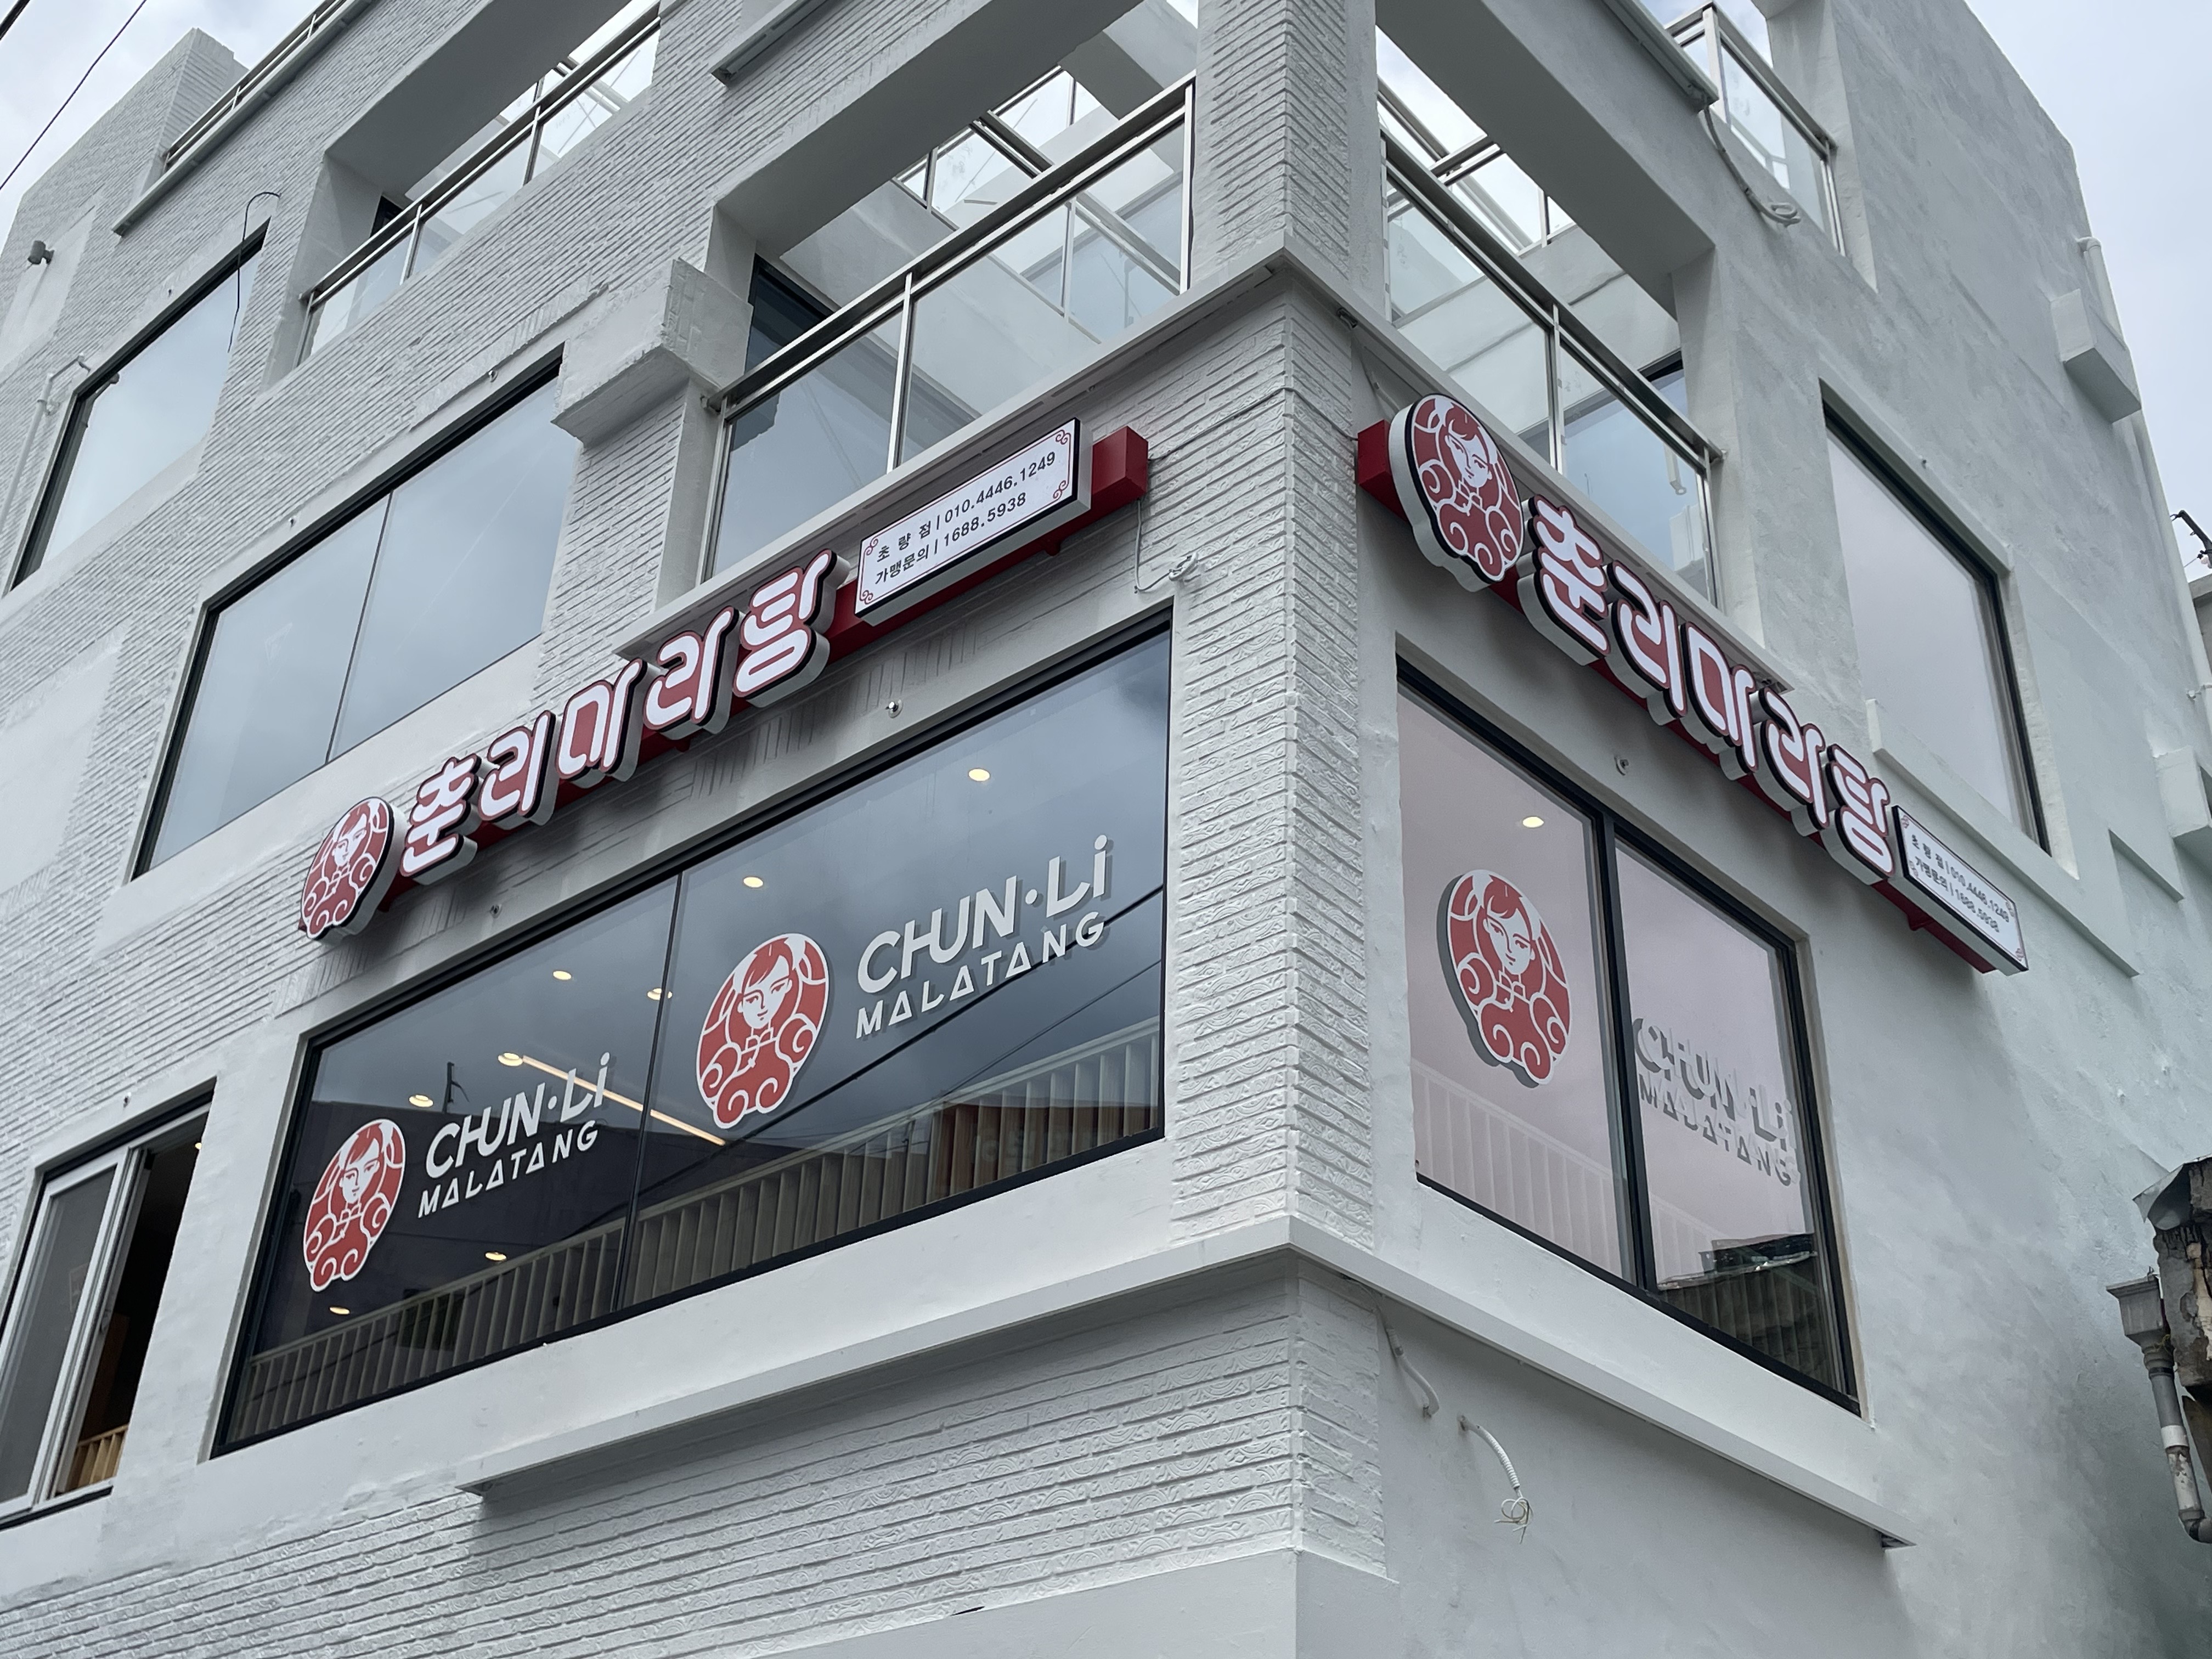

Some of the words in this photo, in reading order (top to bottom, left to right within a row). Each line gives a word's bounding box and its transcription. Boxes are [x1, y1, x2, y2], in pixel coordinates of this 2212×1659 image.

[875, 546, 929, 585] 가맹문의
[944, 492, 1026, 547] 1688.5938
[402, 550, 833, 876] 춘리마라탕
[1536, 496, 1894, 876] 춘리마라탕
[856, 912, 1104, 1039] MALATANG
[417, 1120, 598, 1218] MALATANG
[1639, 1074, 1800, 1186] MALATANG
